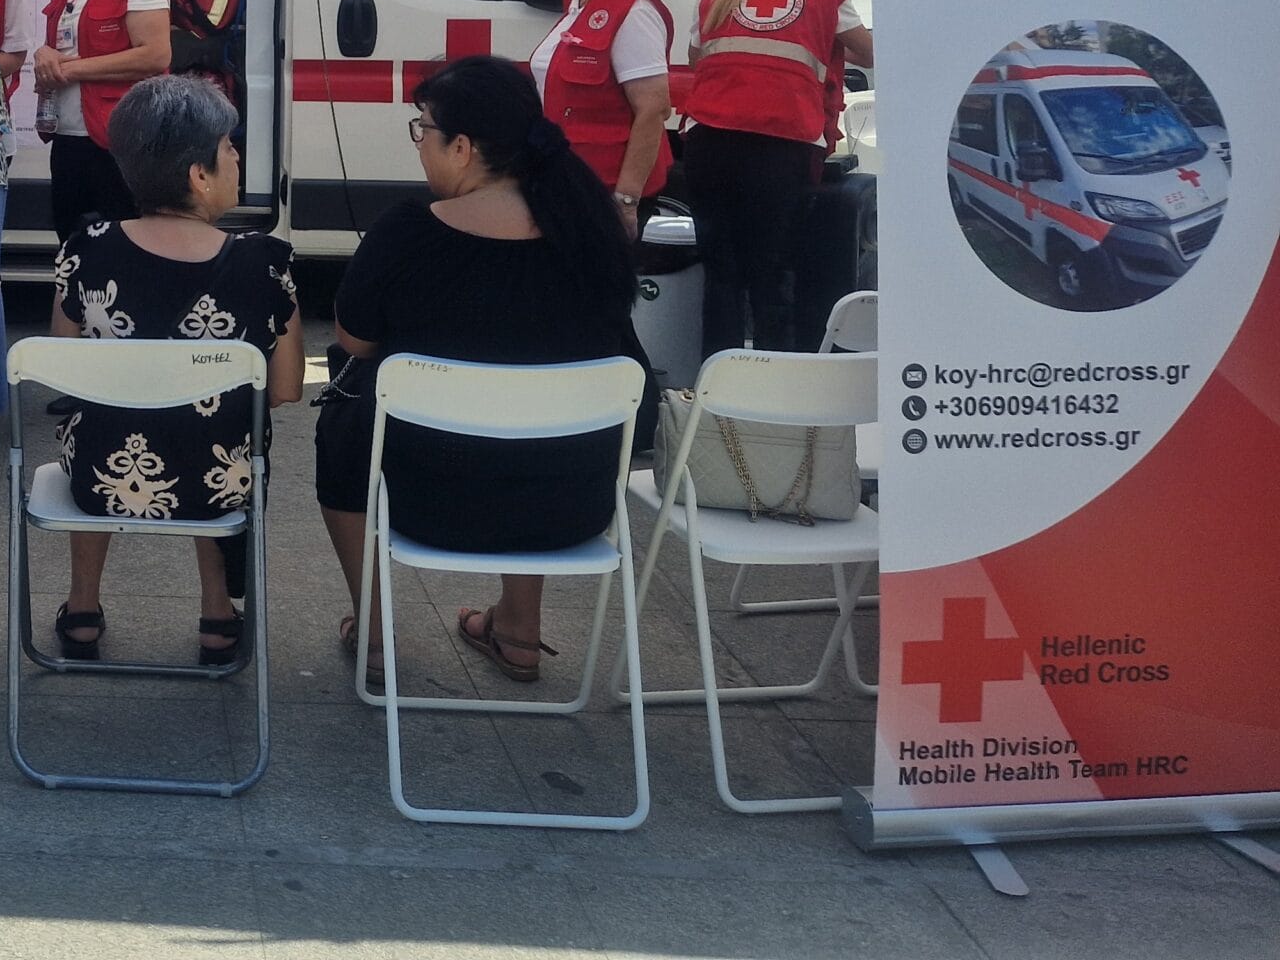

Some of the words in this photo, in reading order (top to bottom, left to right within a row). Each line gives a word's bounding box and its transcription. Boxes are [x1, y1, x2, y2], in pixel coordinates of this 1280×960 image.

[934, 362, 1190, 389] koy-hrc@redcross.gr
[934, 393, 1120, 417] +306909416432
[934, 428, 1141, 451] www.redcross.gr
[1040, 634, 1146, 658] Hellenic
[1040, 664, 1089, 685] Red
[1098, 662, 1170, 683] Cross
[899, 739, 974, 760] Health
[983, 736, 1078, 757] Division
[898, 764, 976, 785] Mobile
[984, 761, 1060, 782] Health
[1069, 759, 1128, 779] Team
[1136, 755, 1189, 776] HRC
